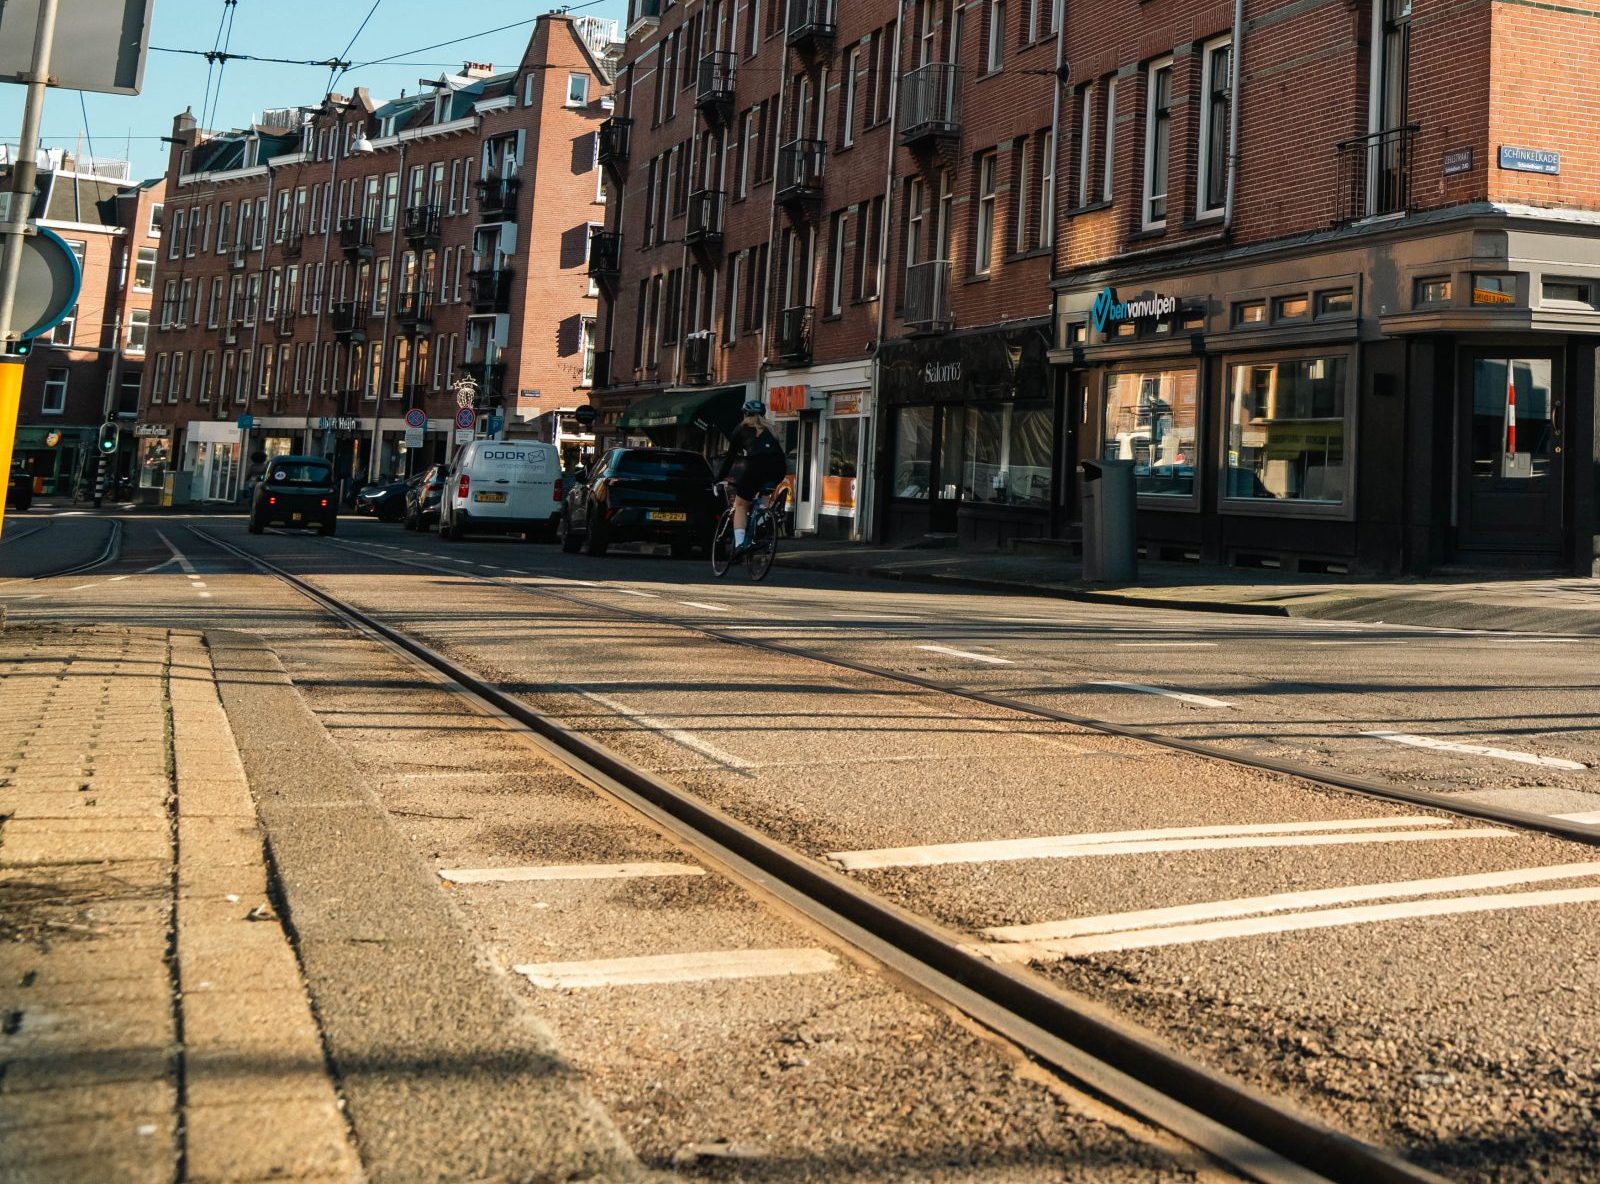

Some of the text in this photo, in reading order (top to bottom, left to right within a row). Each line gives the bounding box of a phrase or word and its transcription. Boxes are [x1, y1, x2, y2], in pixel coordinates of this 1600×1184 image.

[1503, 148, 1558, 163] SCHINKELKADE
[1109, 292, 1176, 320] bertvanvulpen
[484, 451, 525, 459] DOOR
